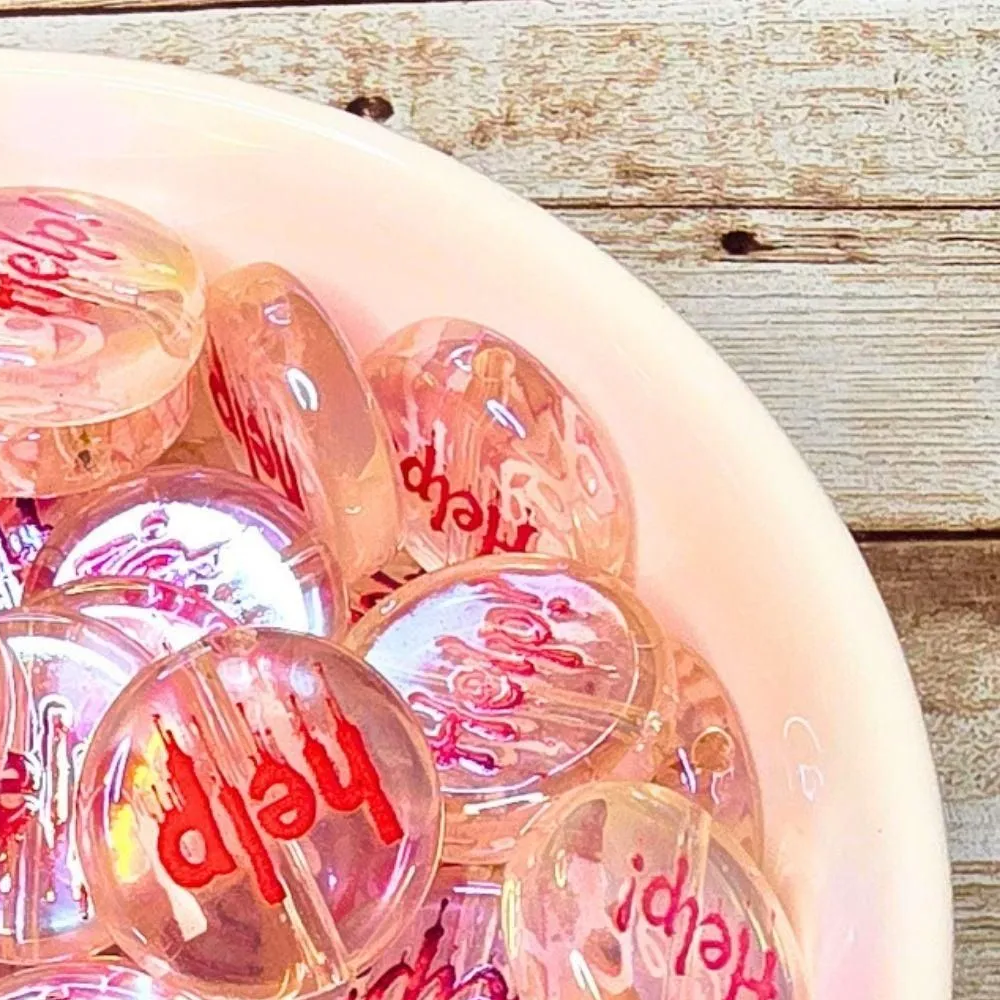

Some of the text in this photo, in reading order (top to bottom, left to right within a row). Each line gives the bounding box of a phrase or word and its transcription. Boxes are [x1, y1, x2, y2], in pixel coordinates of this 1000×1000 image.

[391, 430, 537, 556] Help
[407, 577, 584, 773] Help!
[157, 705, 404, 905] help
